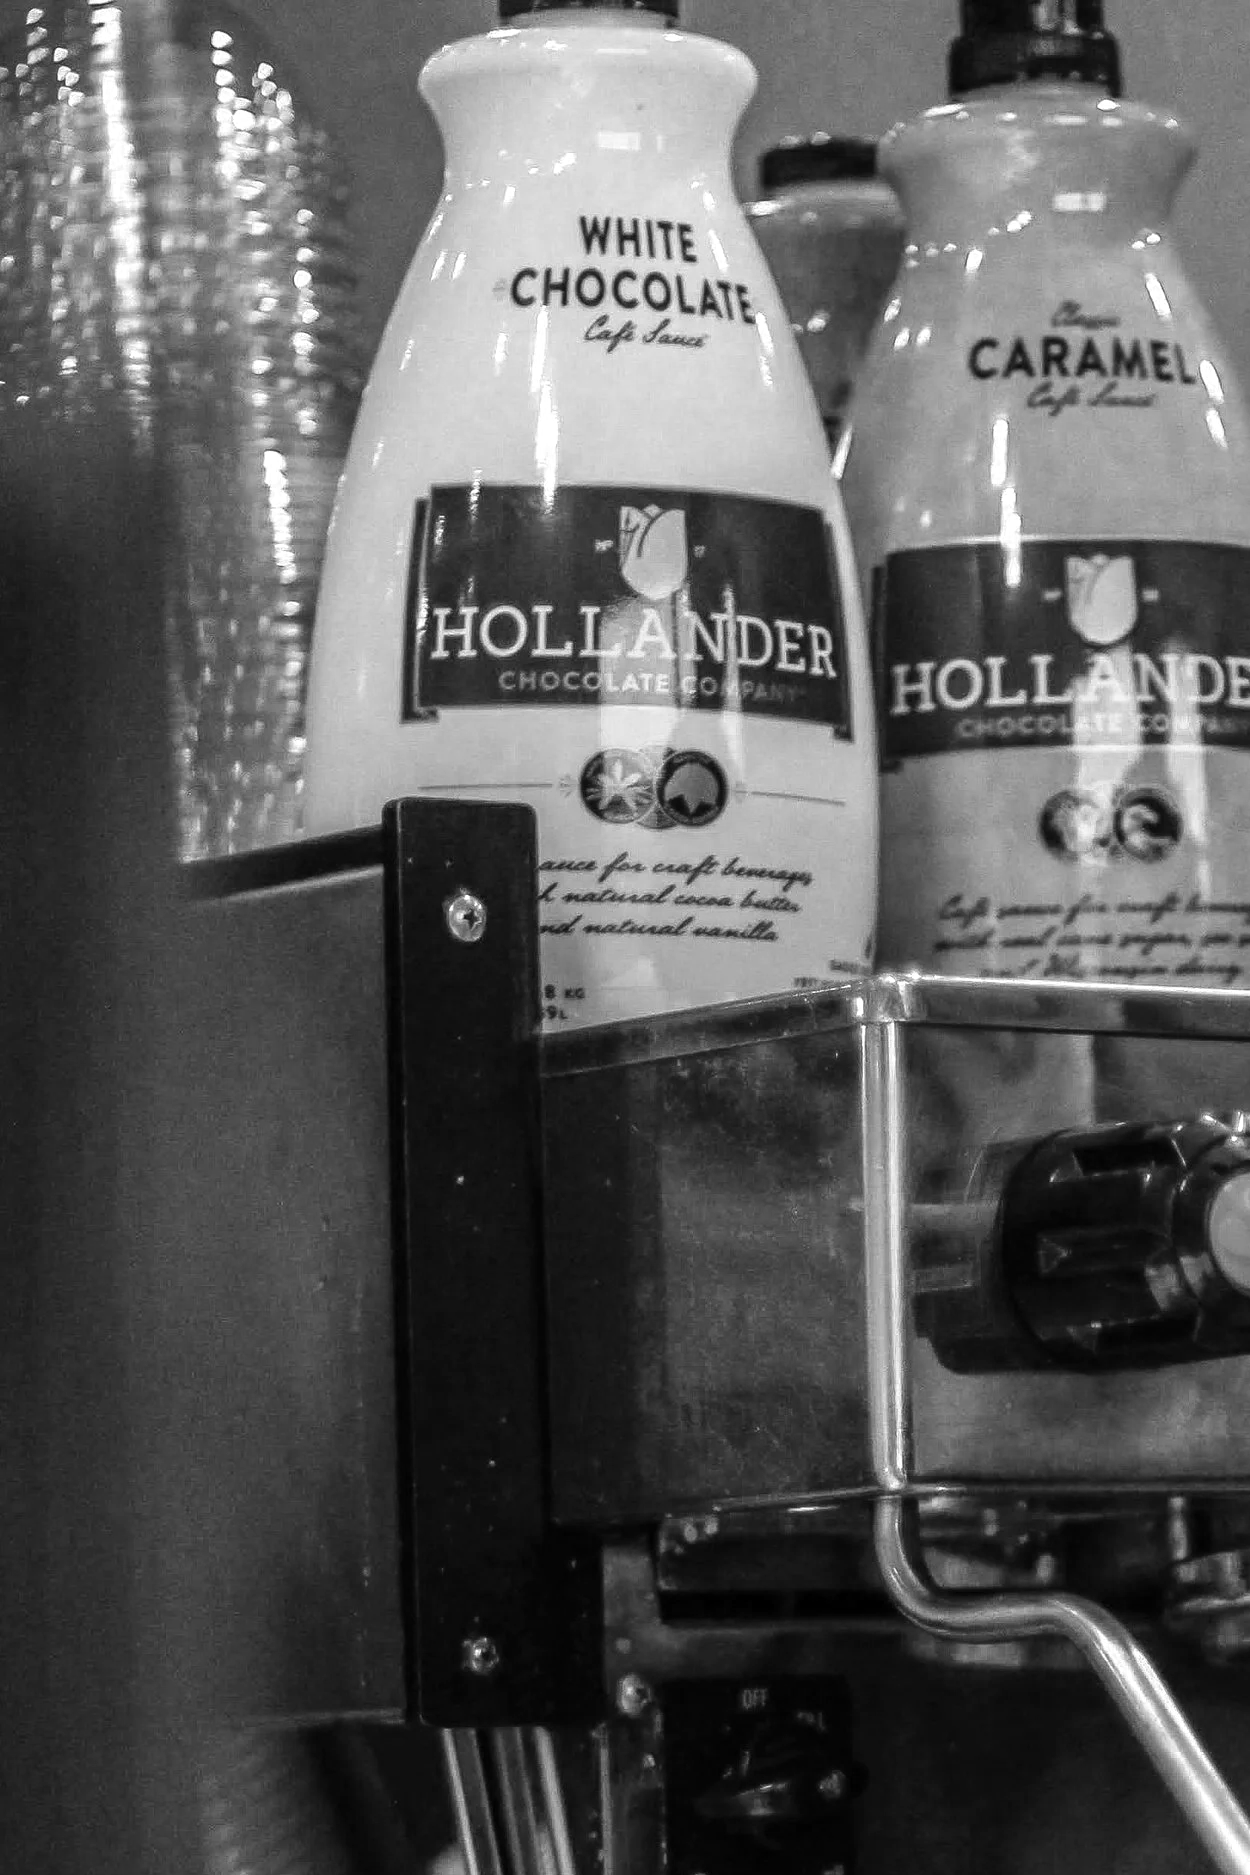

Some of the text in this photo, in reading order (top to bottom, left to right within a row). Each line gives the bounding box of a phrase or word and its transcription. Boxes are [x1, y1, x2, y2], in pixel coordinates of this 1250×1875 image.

[580, 215, 698, 263] WHITE
[510, 267, 757, 325] CHOCOLATE
[968, 335, 1197, 385] CARAMEL
[430, 605, 837, 678] HOLLANDER
[499, 670, 671, 693] CHOCOLATE
[538, 851, 813, 893] auce for craft beverages
[562, 884, 677, 904] natural
[673, 893, 736, 907] cocoa
[738, 889, 801, 912] butter
[540, 914, 779, 942] nd natural vanilla
